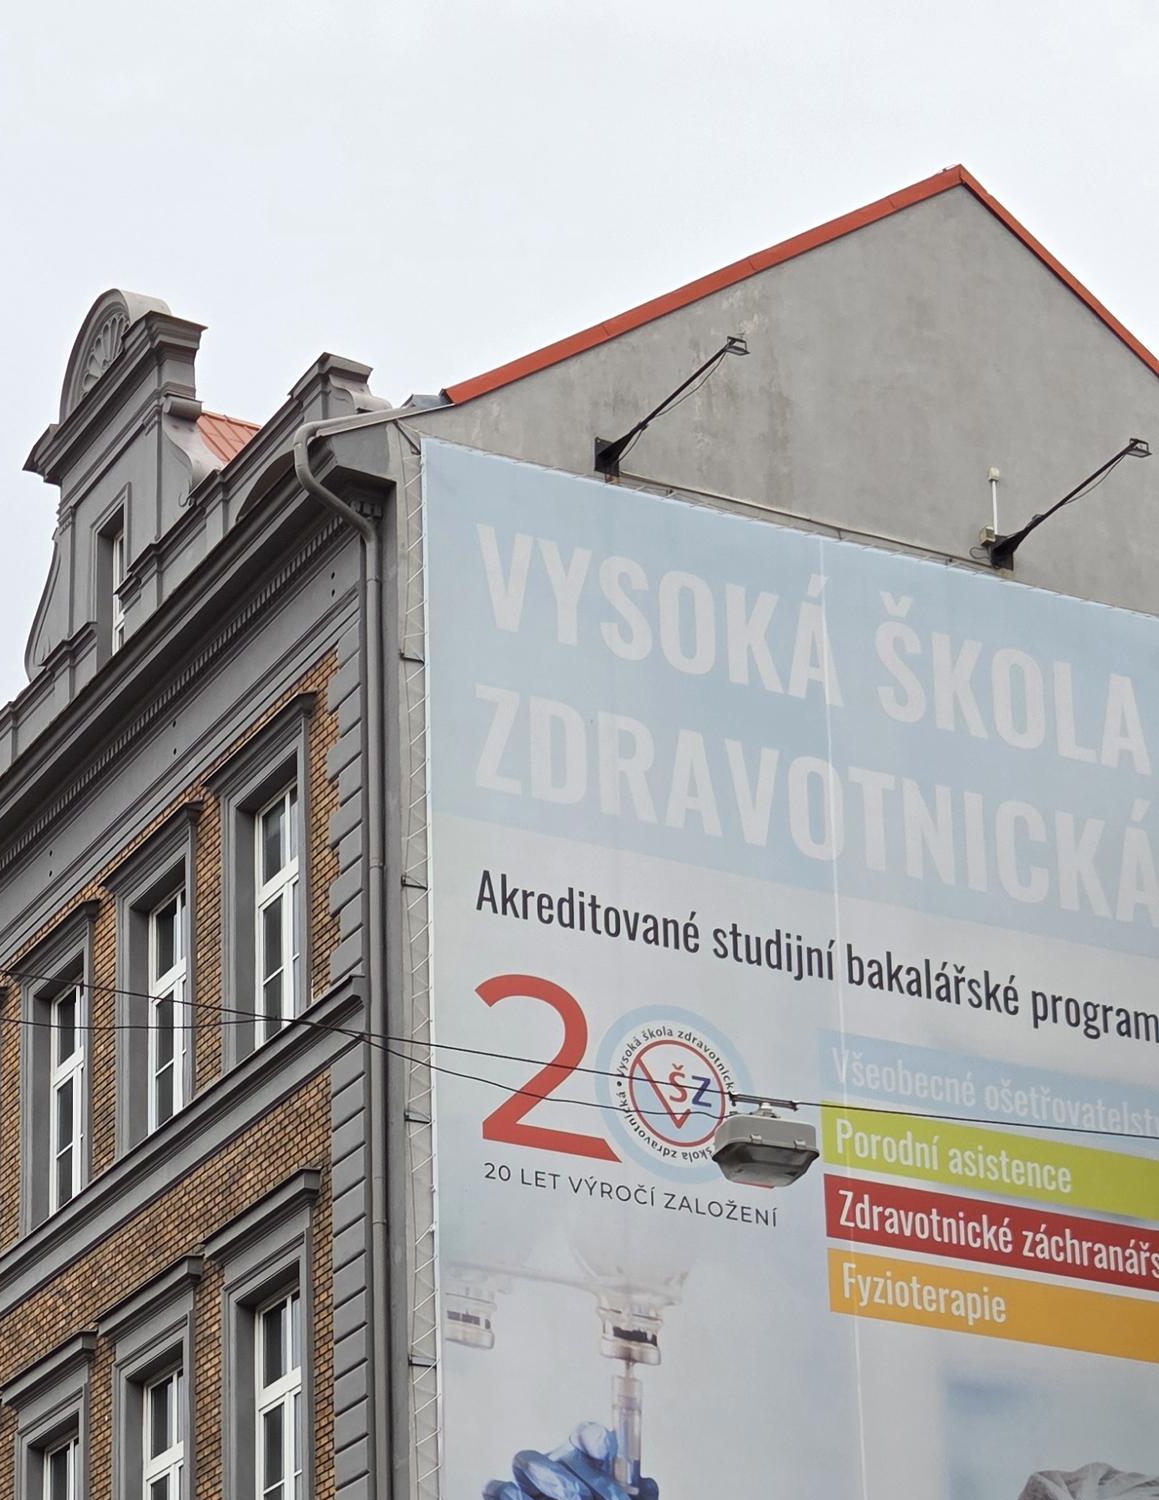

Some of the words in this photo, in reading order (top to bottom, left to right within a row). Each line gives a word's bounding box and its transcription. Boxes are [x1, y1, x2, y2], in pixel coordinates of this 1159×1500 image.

[476, 522, 844, 708] VYSOKÁ
[874, 591, 1153, 777] ŠKOLA
[474, 682, 1159, 929] ZDRAVOTNICKÁ
[476, 869, 700, 954] Akreditované
[712, 922, 835, 981] studijní
[846, 943, 1020, 1016] bakalářské
[642, 1025, 674, 1042] škola
[677, 1031, 739, 1098] zdravotnick
[831, 1047, 976, 1108] Všeobecné
[835, 1118, 940, 1171] Porodní
[948, 1146, 1073, 1194] asistence
[483, 1162, 511, 1182] 20
[521, 1168, 561, 1191] LET
[568, 1176, 655, 1207] VÝROČÍ
[663, 1192, 779, 1227] ZALOŽENÍ
[838, 1189, 1013, 1253] Zdravotnické
[842, 1262, 1008, 1326] Fyzioterapie
